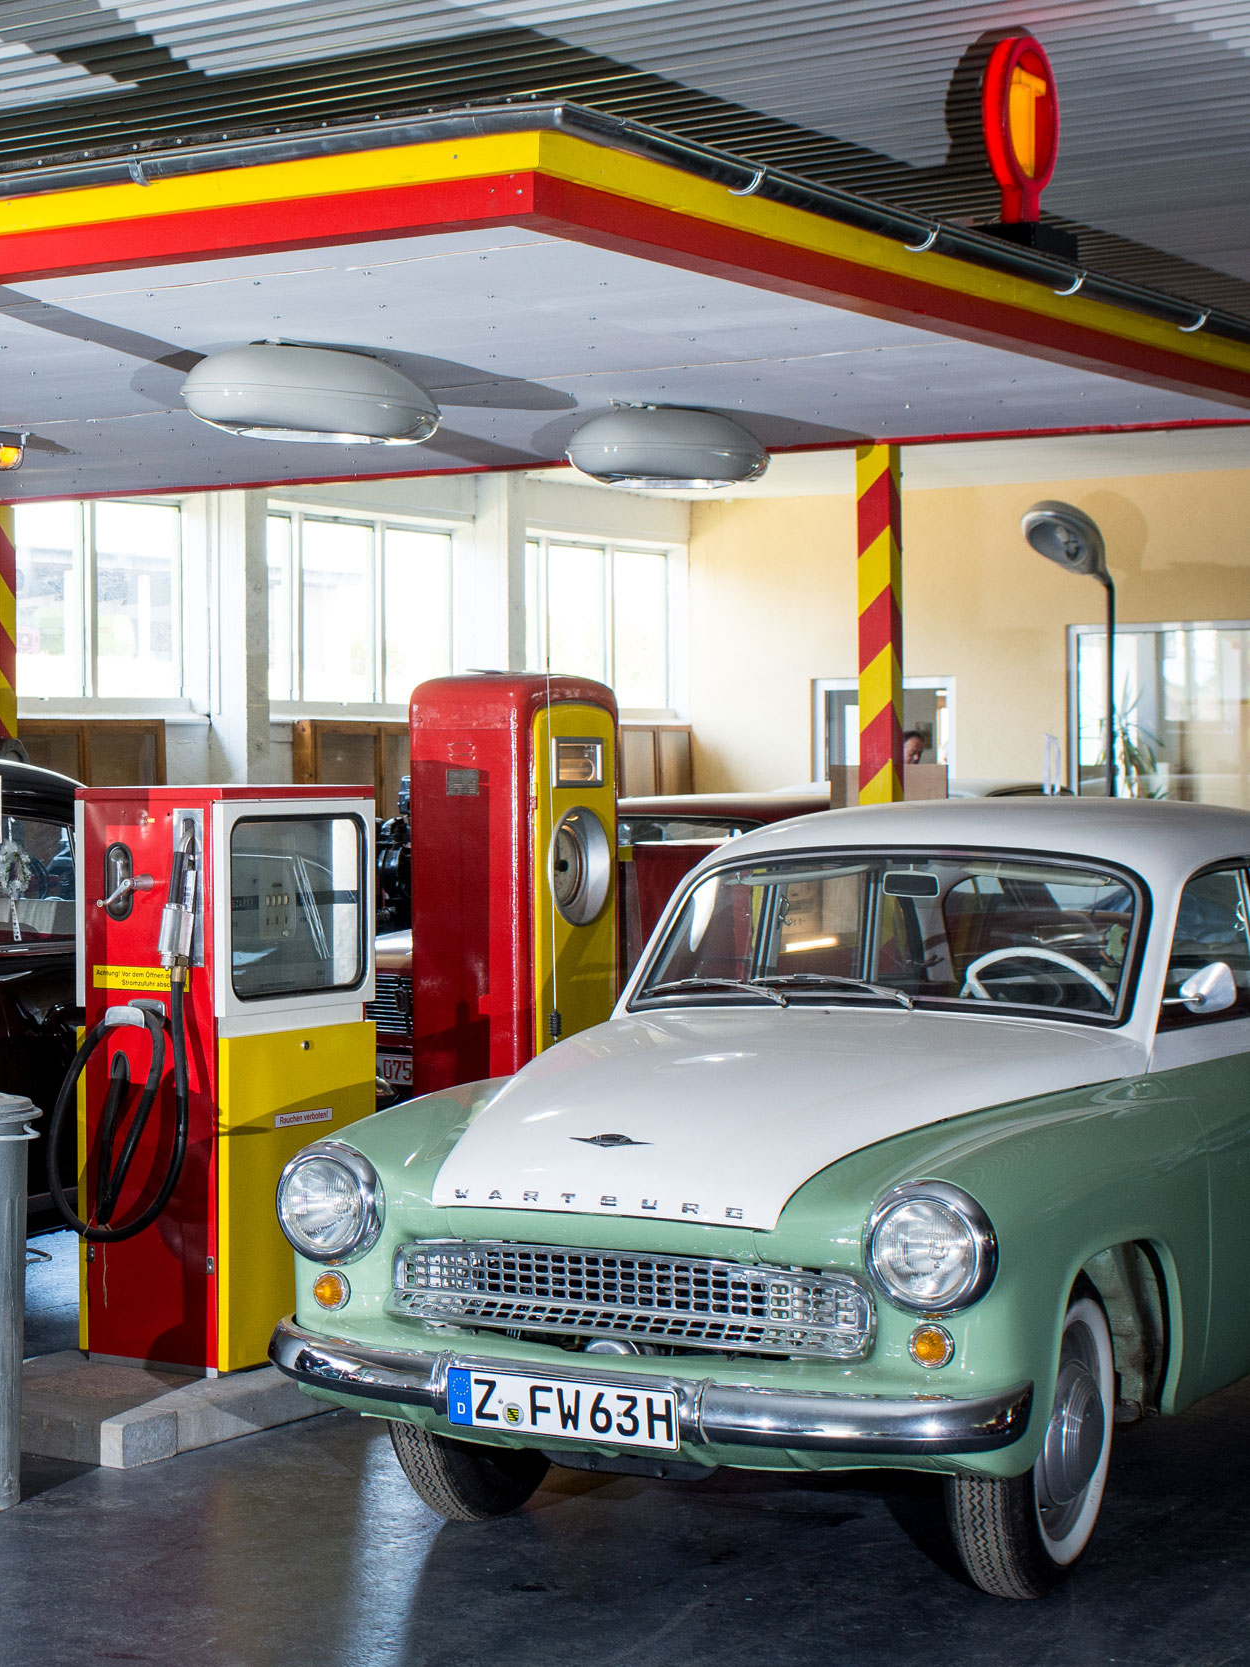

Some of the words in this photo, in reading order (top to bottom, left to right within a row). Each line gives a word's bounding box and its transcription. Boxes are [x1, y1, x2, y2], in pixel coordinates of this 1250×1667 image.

[280, 1114, 303, 1125] Rauchen
[454, 1188, 743, 1220] WARTBURG
[456, 1401, 467, 1415] D
[473, 1378, 499, 1421] Z
